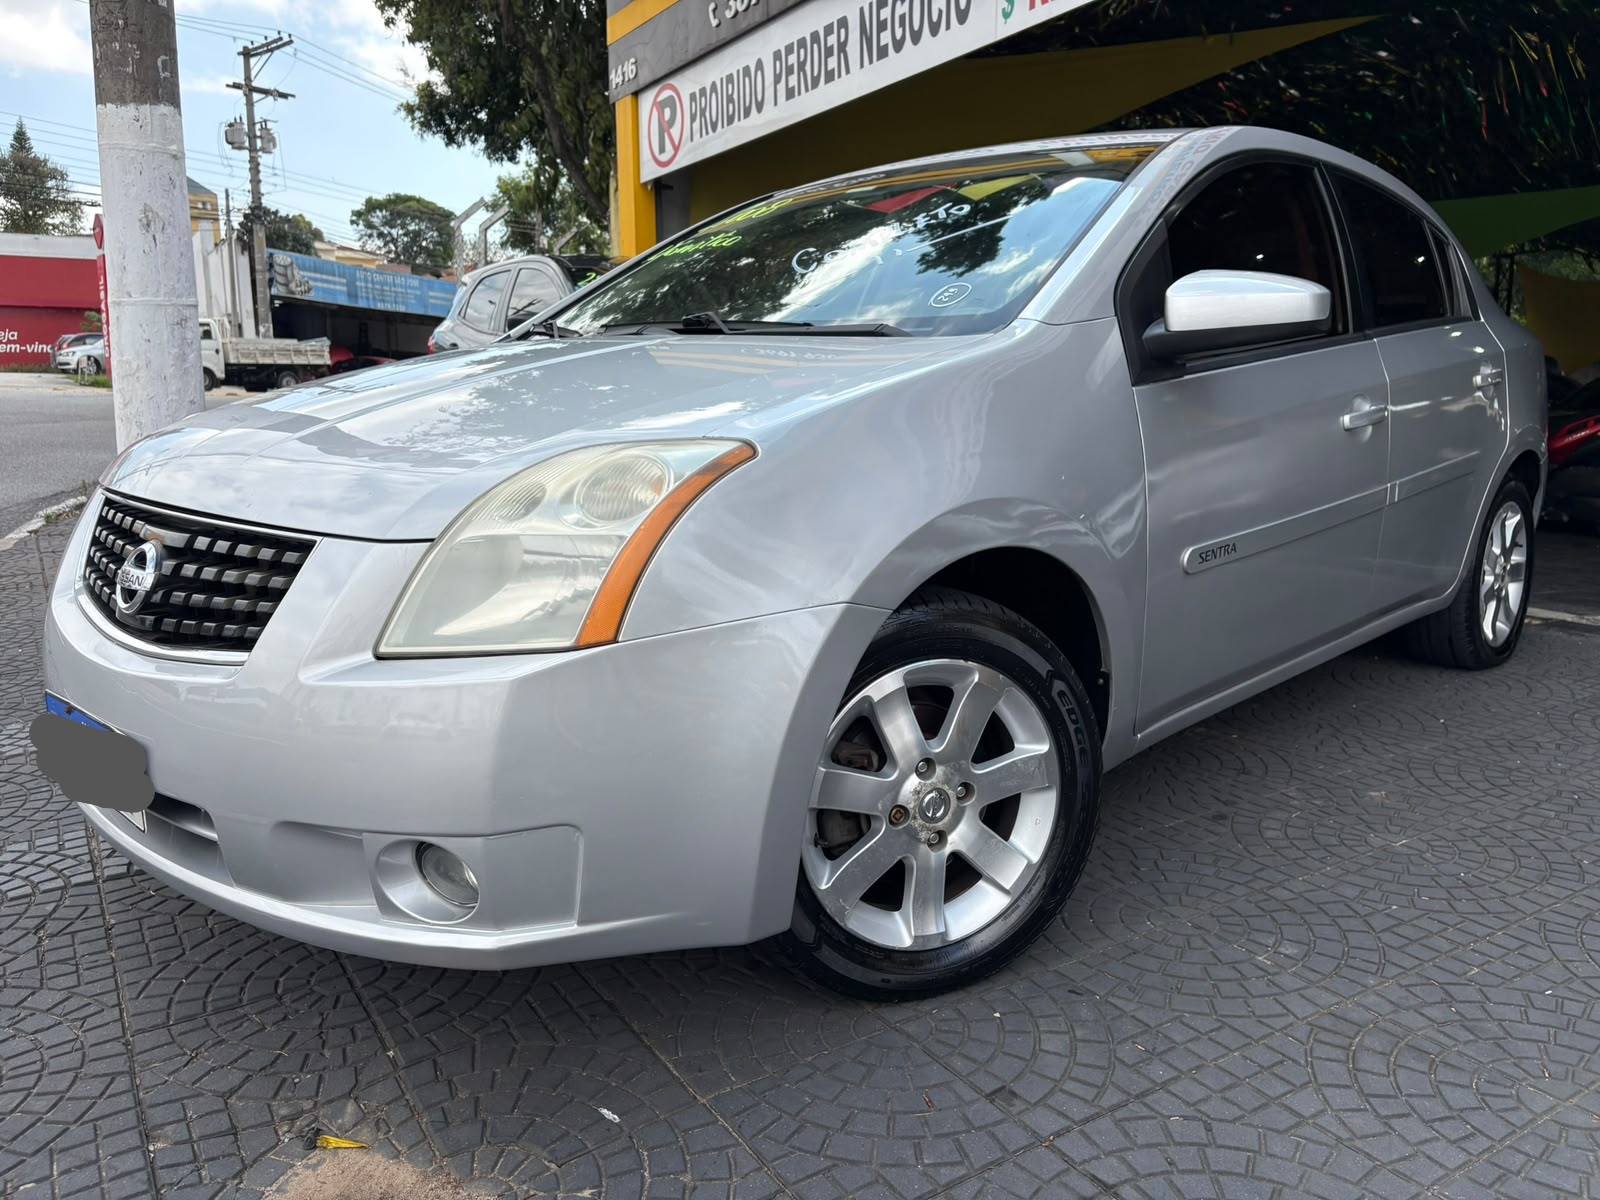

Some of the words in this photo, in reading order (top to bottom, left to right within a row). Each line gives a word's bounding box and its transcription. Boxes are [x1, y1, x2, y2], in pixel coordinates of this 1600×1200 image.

[610, 57, 637, 89] 1416
[689, 57, 766, 143] PROIBIDO
[773, 16, 851, 107] PERDER
[99, 275, 110, 357] DROGASIL
[1198, 542, 1237, 565] SENTRA
[1056, 689, 1090, 769] EDGE
